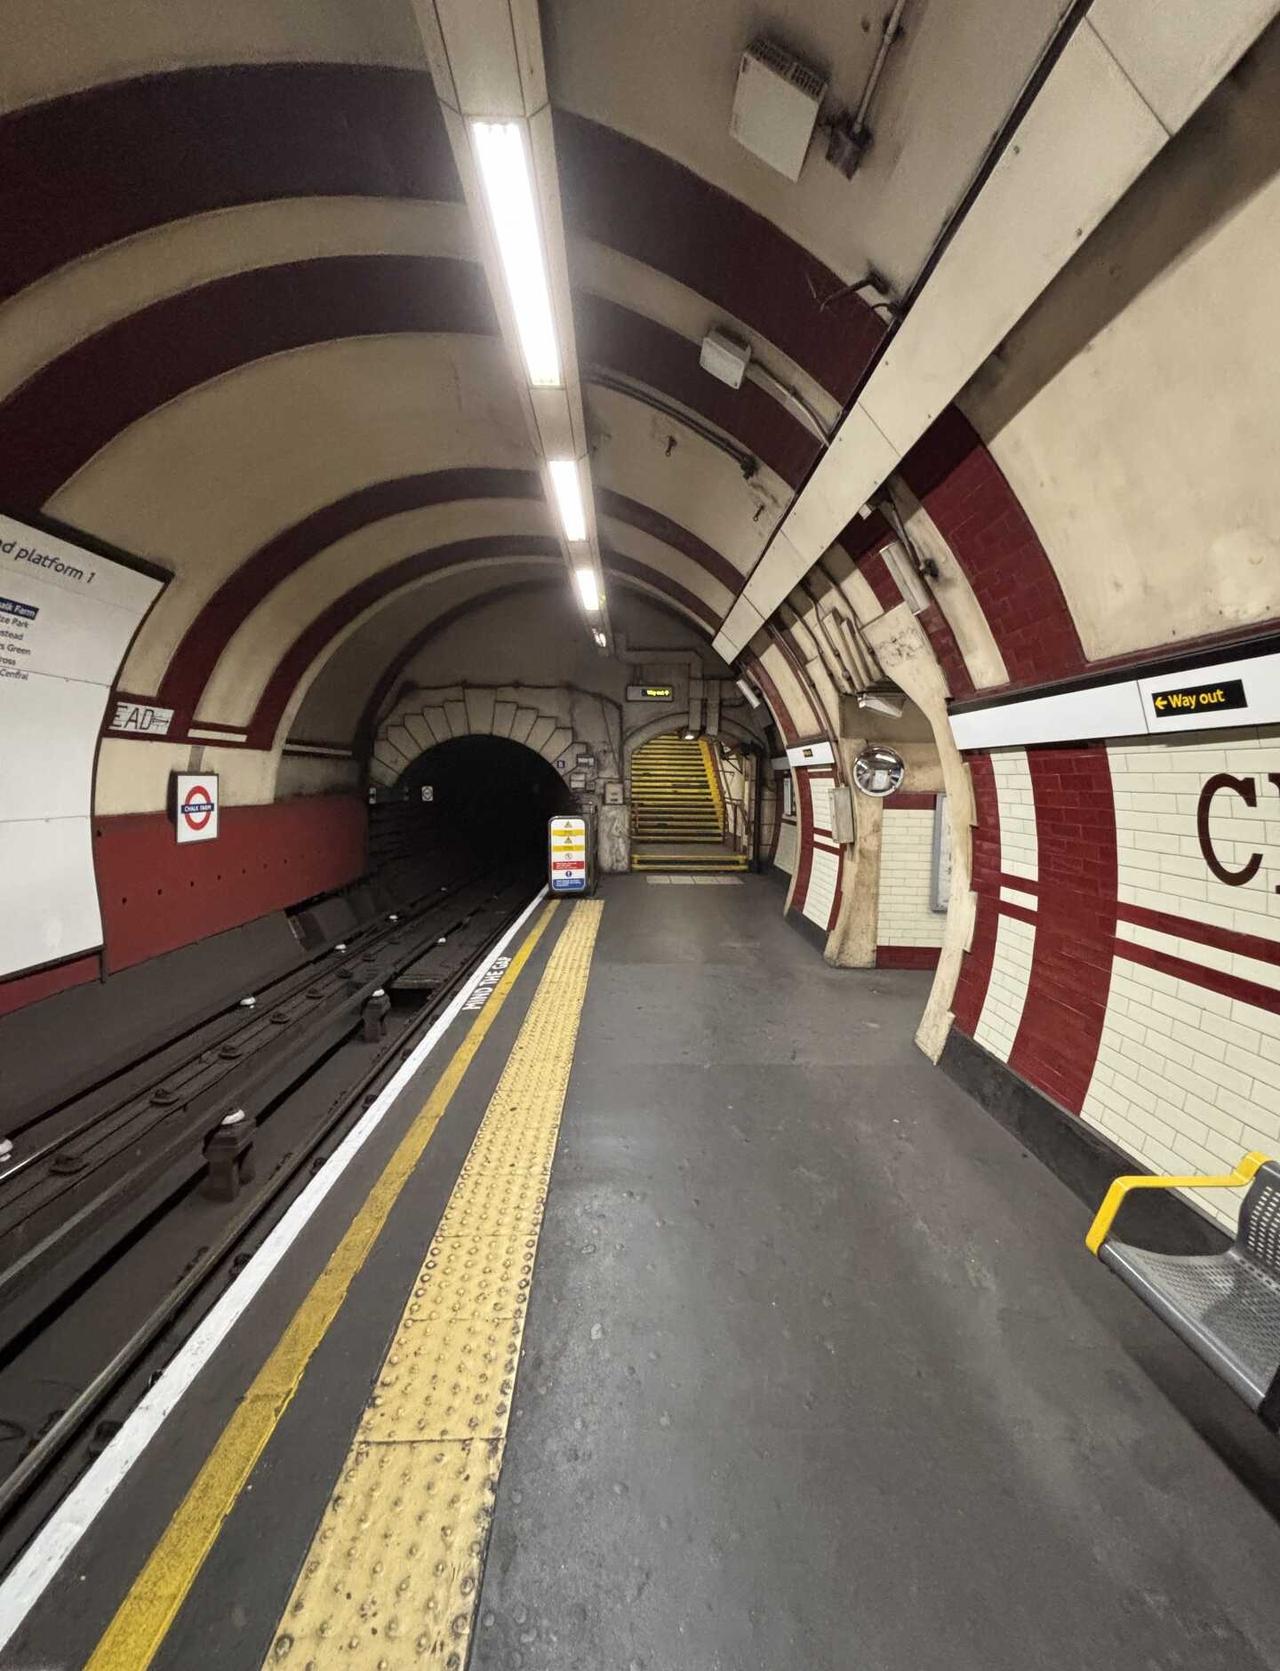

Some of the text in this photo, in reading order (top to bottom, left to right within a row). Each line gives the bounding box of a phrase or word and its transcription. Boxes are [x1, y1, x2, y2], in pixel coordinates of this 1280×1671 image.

[0, 539, 96, 584] d platform 1
[12, 617, 28, 628] Park
[7, 643, 31, 655] Green
[0, 668, 28, 680] Central
[1168, 688, 1225, 709] Way out
[1197, 773, 1280, 895] C
[462, 956, 513, 1010] MIND THE GAP
